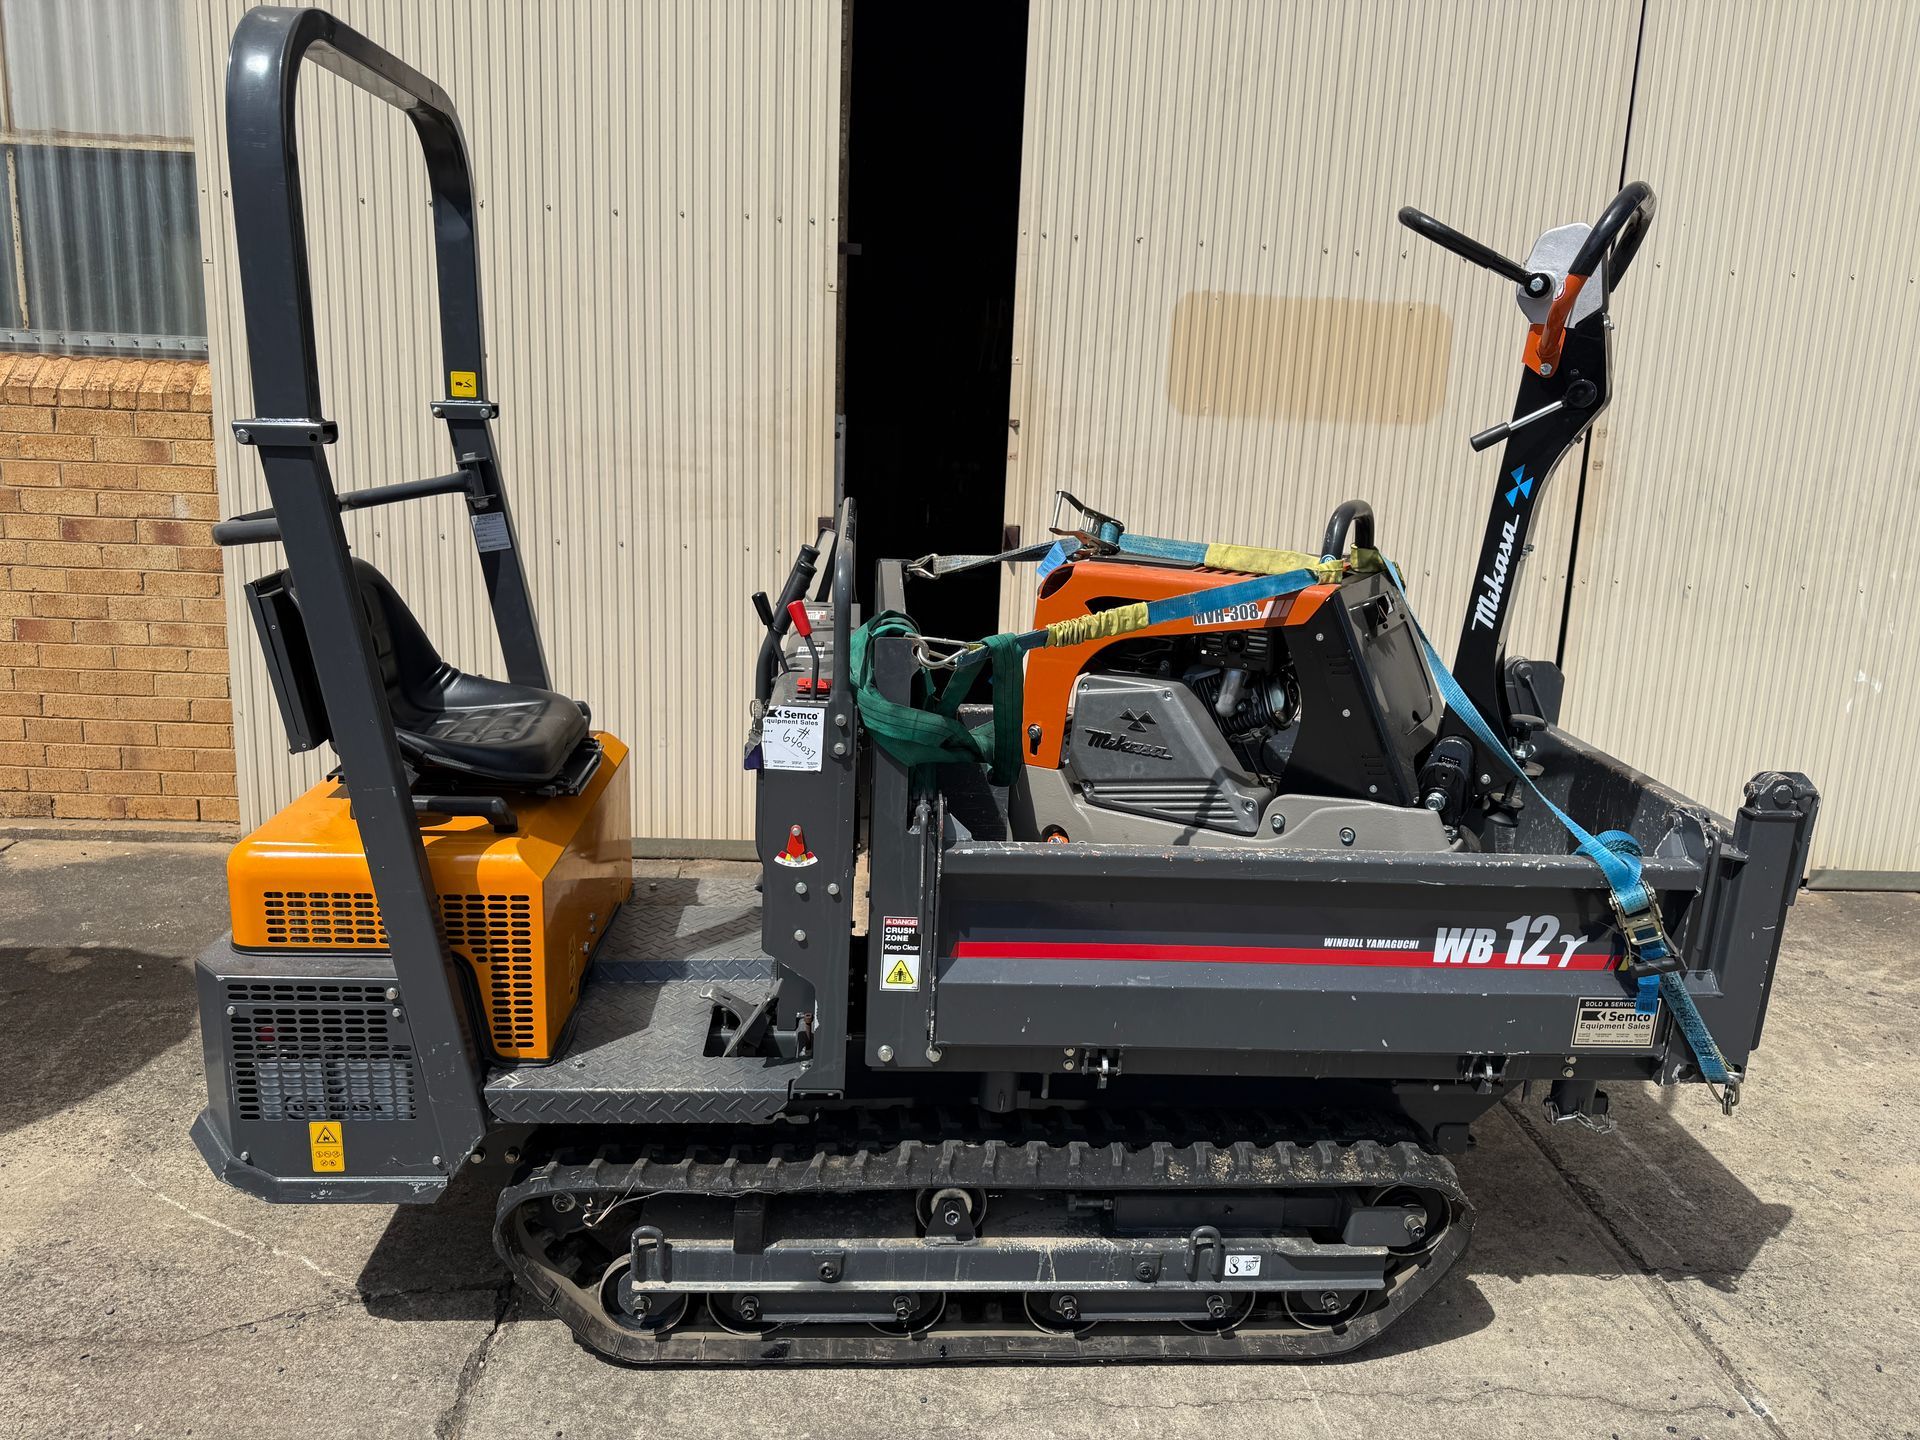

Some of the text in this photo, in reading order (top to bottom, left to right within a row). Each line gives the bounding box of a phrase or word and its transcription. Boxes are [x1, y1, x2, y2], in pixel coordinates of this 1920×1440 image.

[1471, 514, 1519, 631] Mikasa
[784, 710, 818, 720] Semco
[1084, 728, 1173, 760] Mikasa
[884, 943, 901, 952] Keep
[1323, 937, 1420, 949] WINBULL YAMAGUCHI
[1433, 927, 1497, 964] WB
[1608, 1011, 1651, 1022] Semco
[1580, 1022, 1651, 1030] Equipment Sales
